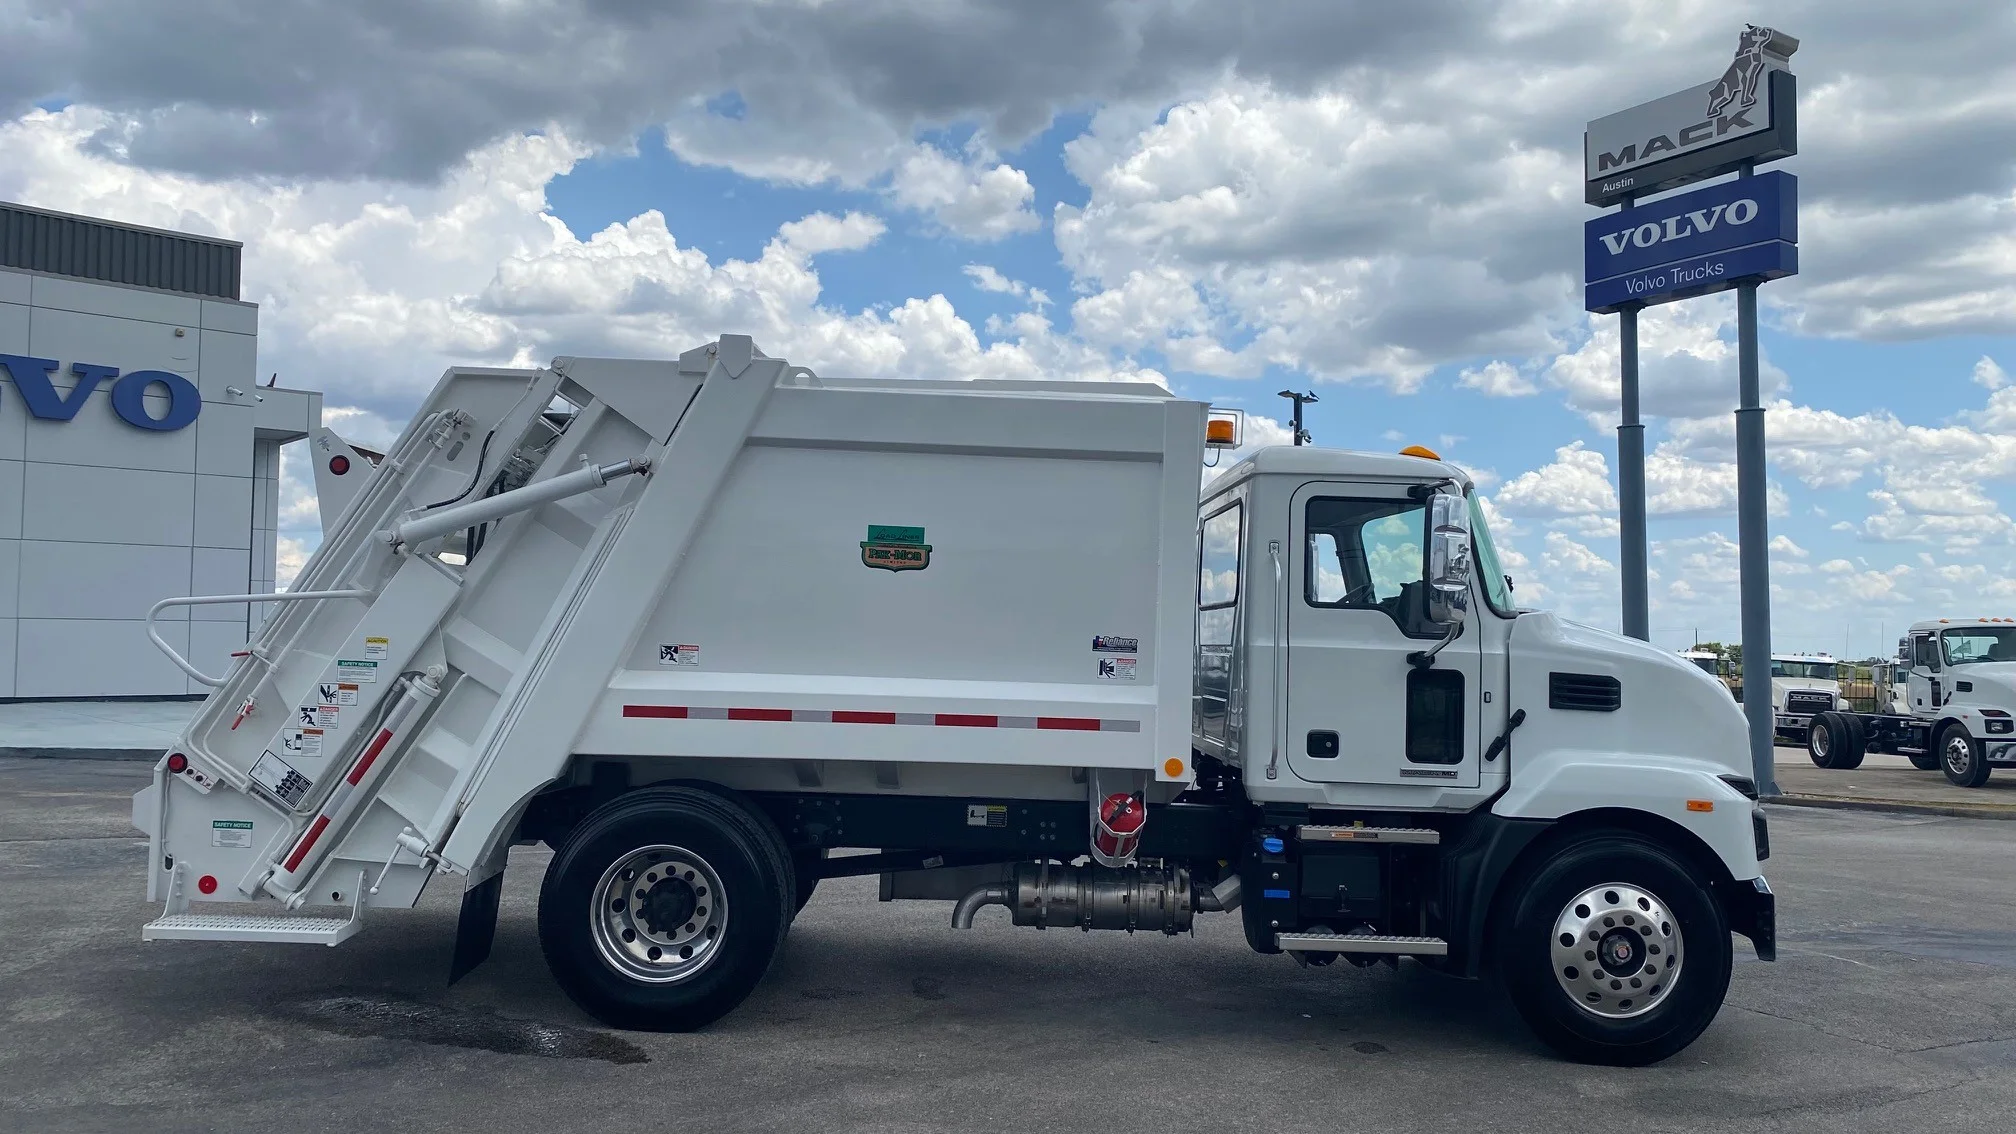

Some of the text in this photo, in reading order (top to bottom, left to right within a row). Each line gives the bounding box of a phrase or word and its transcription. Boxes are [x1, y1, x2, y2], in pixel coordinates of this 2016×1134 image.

[1598, 107, 1755, 172] MACK
[1602, 176, 1634, 193] Austin
[1599, 198, 1759, 256] VOLVO
[1626, 261, 1725, 295] Volvo Trucks
[0, 353, 201, 431] VO
[1103, 636, 1137, 646] Reliance
